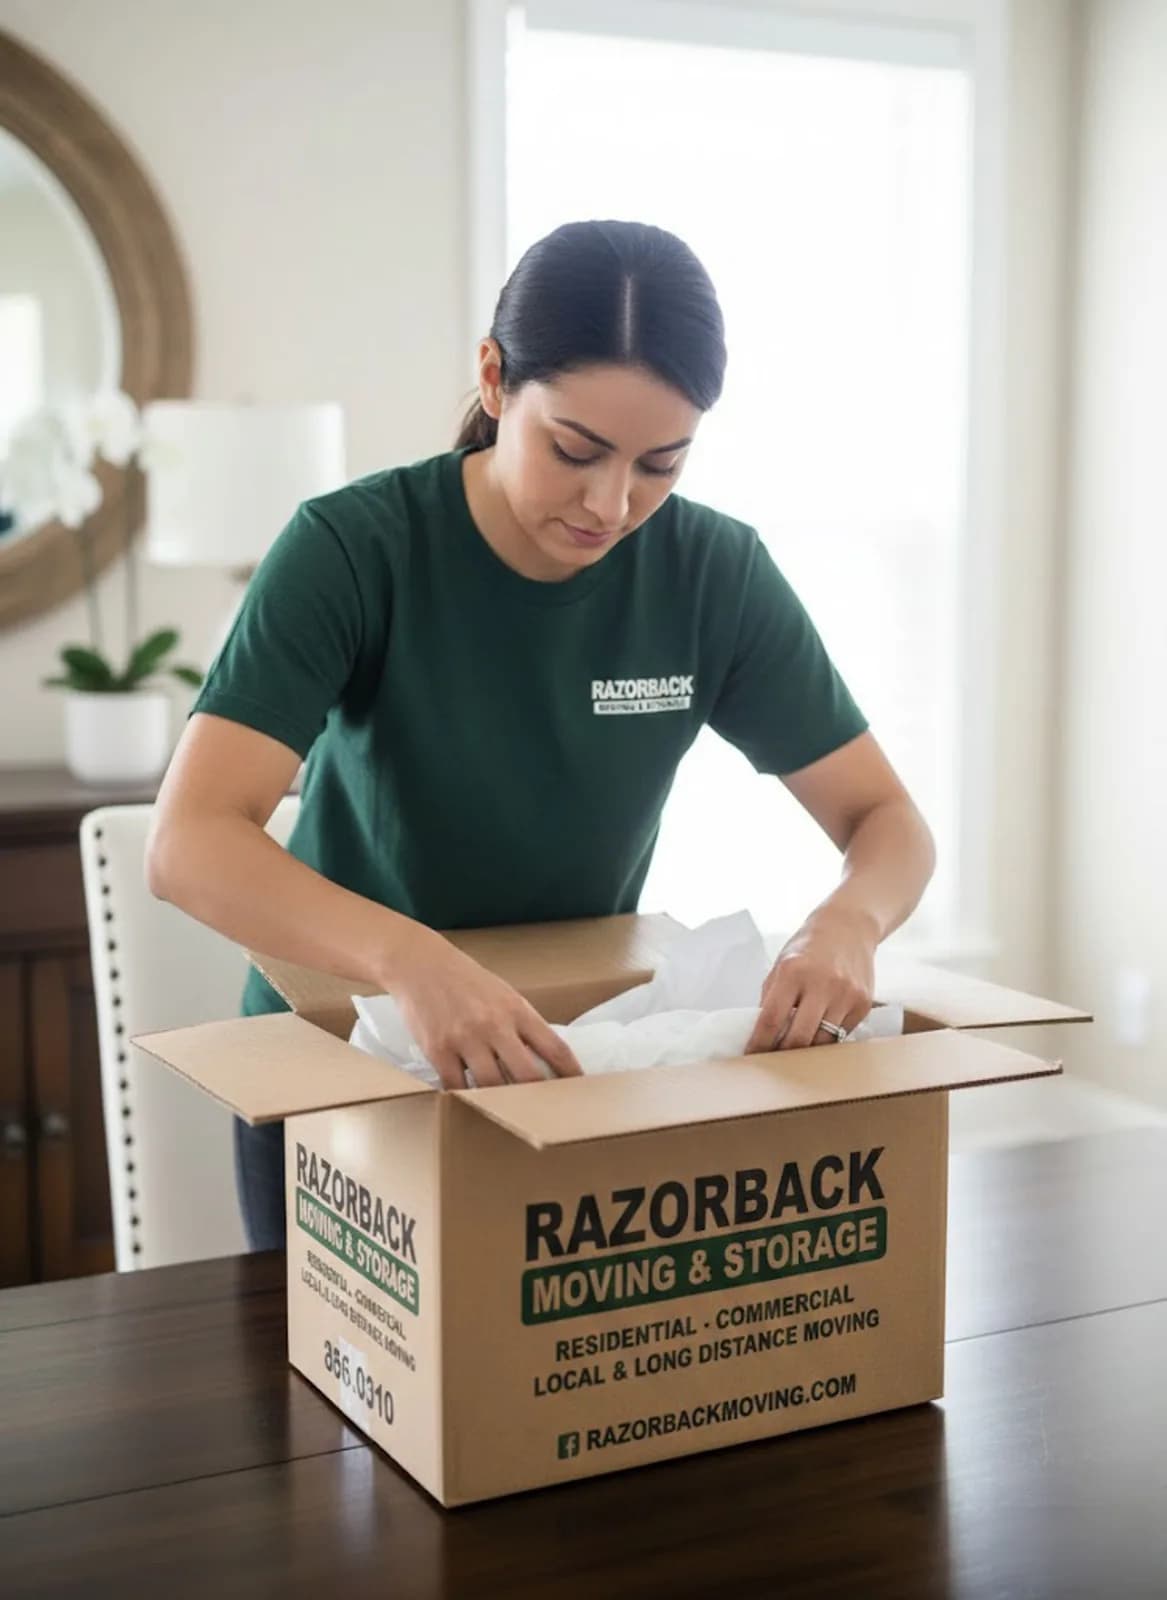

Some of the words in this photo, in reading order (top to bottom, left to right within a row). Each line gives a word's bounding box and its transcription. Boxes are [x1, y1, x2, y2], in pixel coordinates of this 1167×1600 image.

[591, 675, 694, 699] RAZORBACK
[296, 1142, 417, 1265] RAZORBACK
[525, 1146, 885, 1262] RAZORBACK
[357, 1240, 416, 1305] STORAGE
[532, 1259, 676, 1314] MOVING
[688, 1249, 711, 1286] &
[724, 1217, 878, 1279] STORAGE
[534, 1365, 605, 1397] LOCAL
[613, 1361, 628, 1382] &
[635, 1348, 691, 1377] LONG
[699, 1326, 797, 1364] DISTANCE
[803, 1308, 880, 1342] MOVING
[555, 1316, 697, 1362] RESIDENTIAL
[716, 1284, 855, 1330] COMMERCIAL
[586, 1373, 857, 1451] RAZORBACKMOVING.COM
